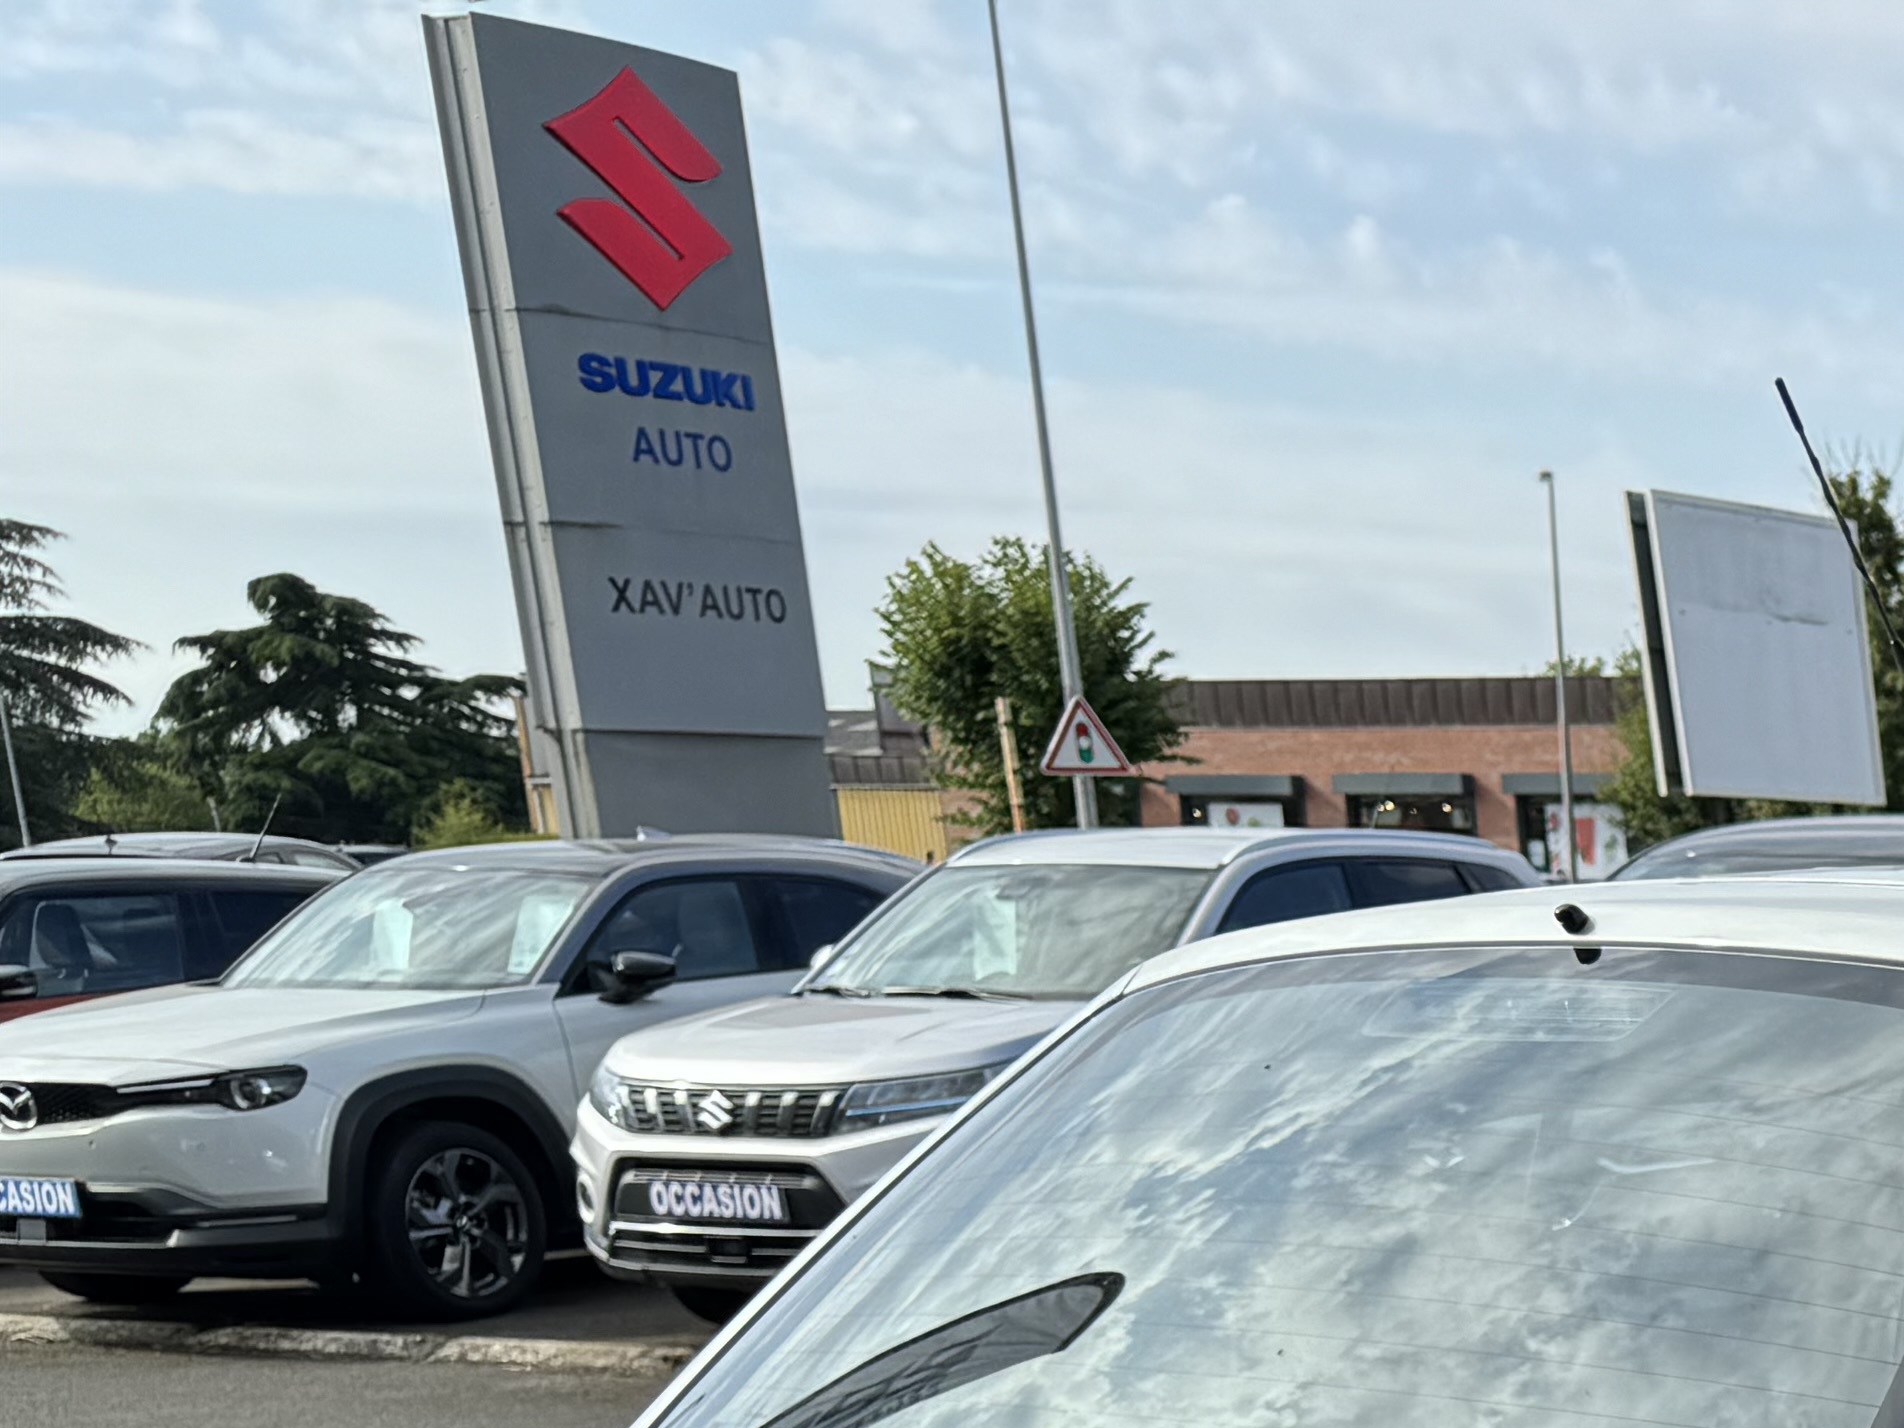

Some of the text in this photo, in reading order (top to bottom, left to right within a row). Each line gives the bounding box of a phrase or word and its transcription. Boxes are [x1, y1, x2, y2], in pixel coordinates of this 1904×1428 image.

[578, 353, 755, 411] SUZUKI
[633, 427, 732, 472] AUTO
[608, 576, 787, 624] XAV'AUTO
[649, 1181, 783, 1220] OCCASION
